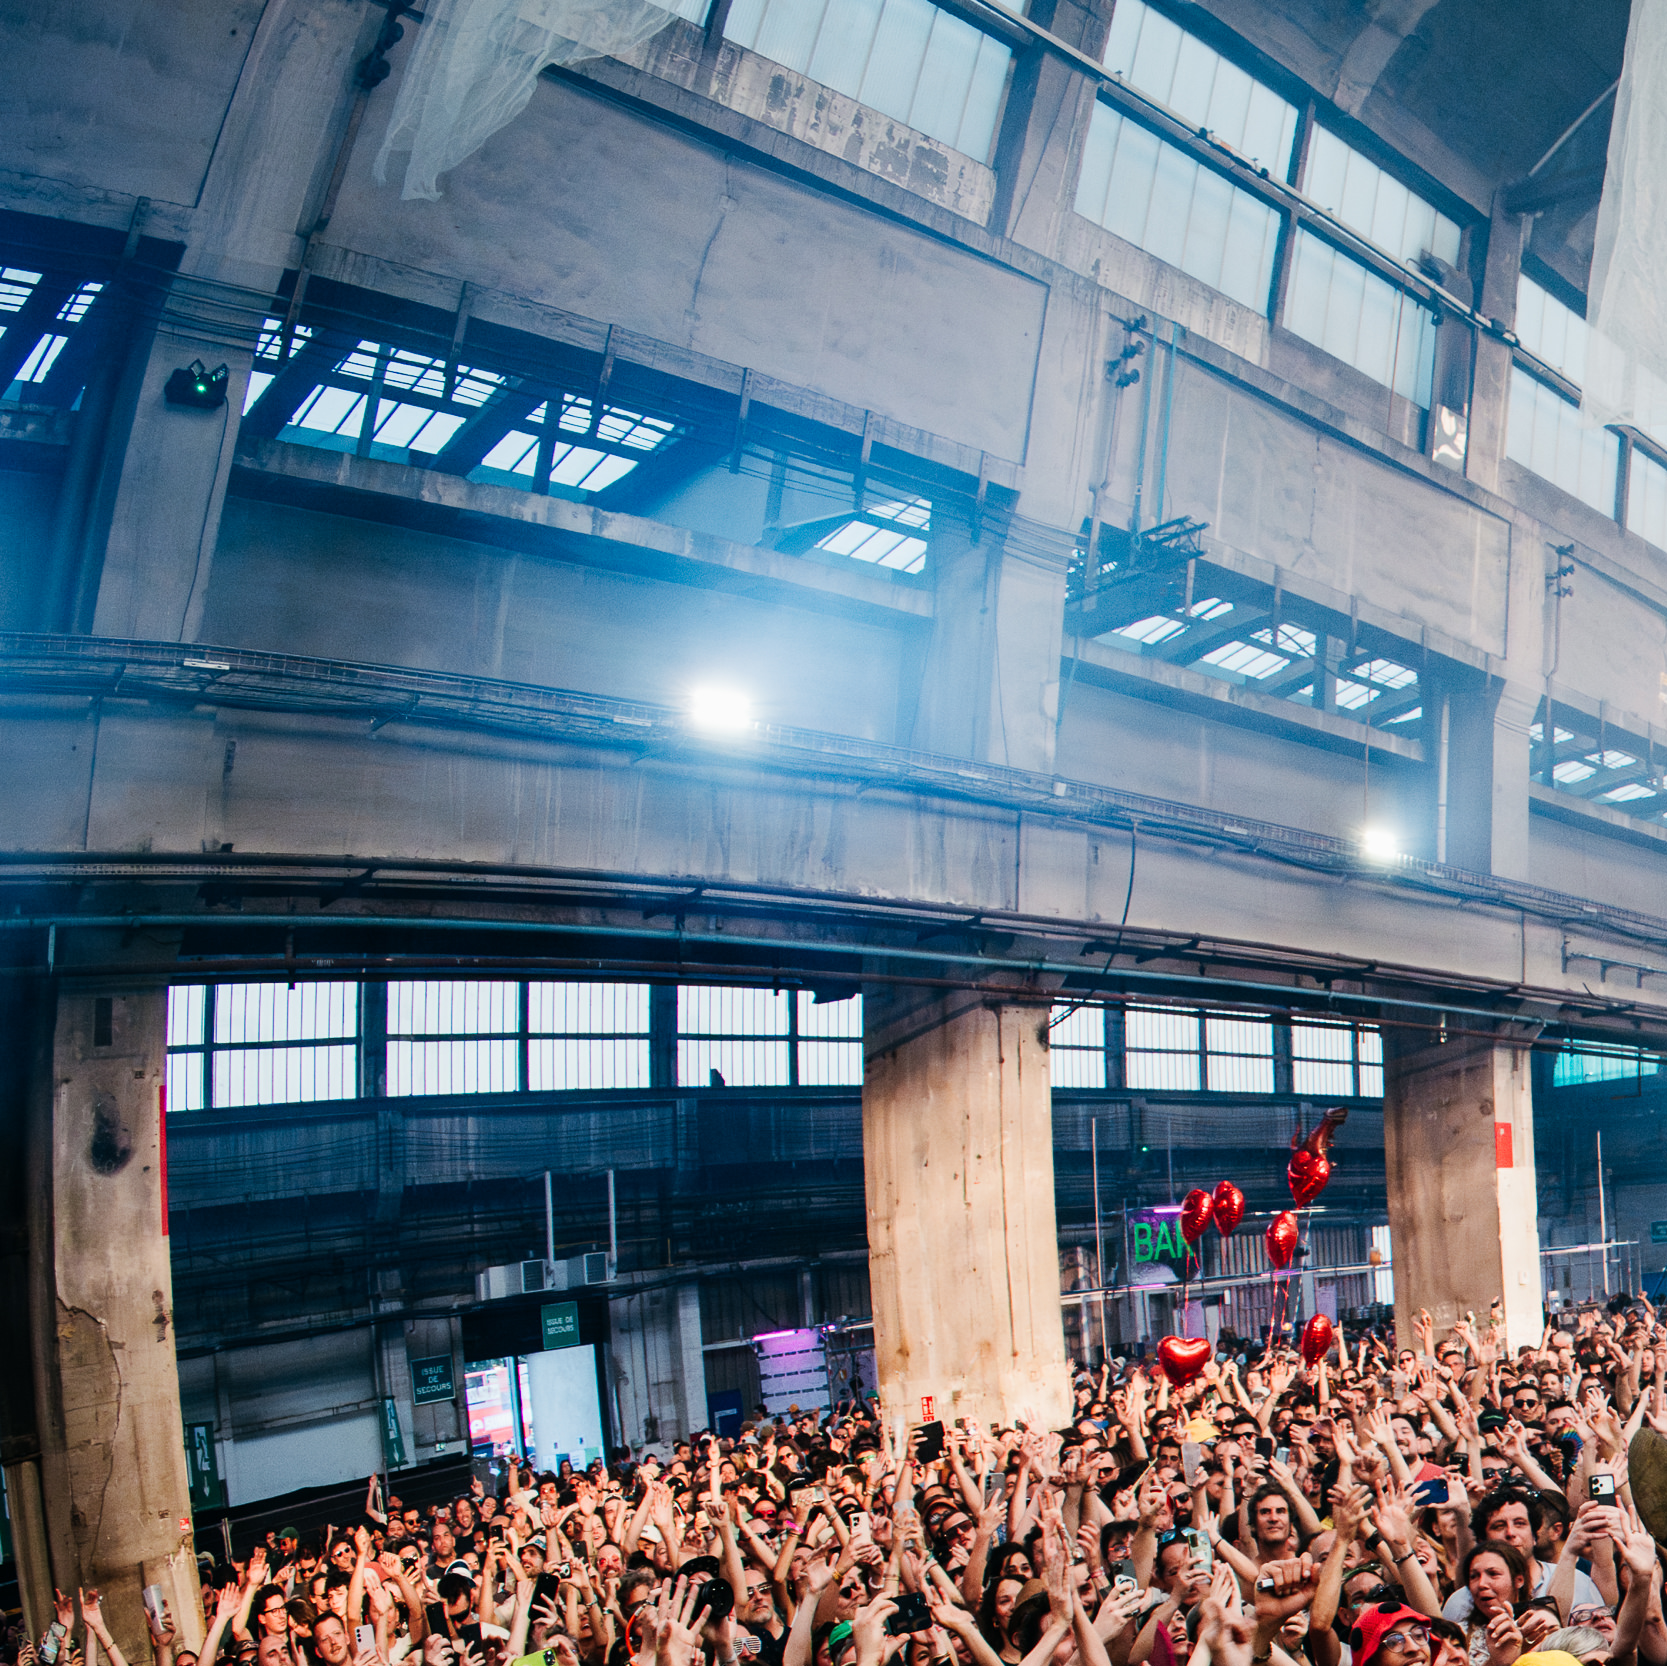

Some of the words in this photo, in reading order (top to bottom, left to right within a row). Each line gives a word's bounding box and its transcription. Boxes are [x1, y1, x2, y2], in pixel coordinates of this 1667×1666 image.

[421, 1365, 445, 1377] ISSUE
[428, 1376, 438, 1384] DE
[416, 1382, 452, 1395] SECOURS
